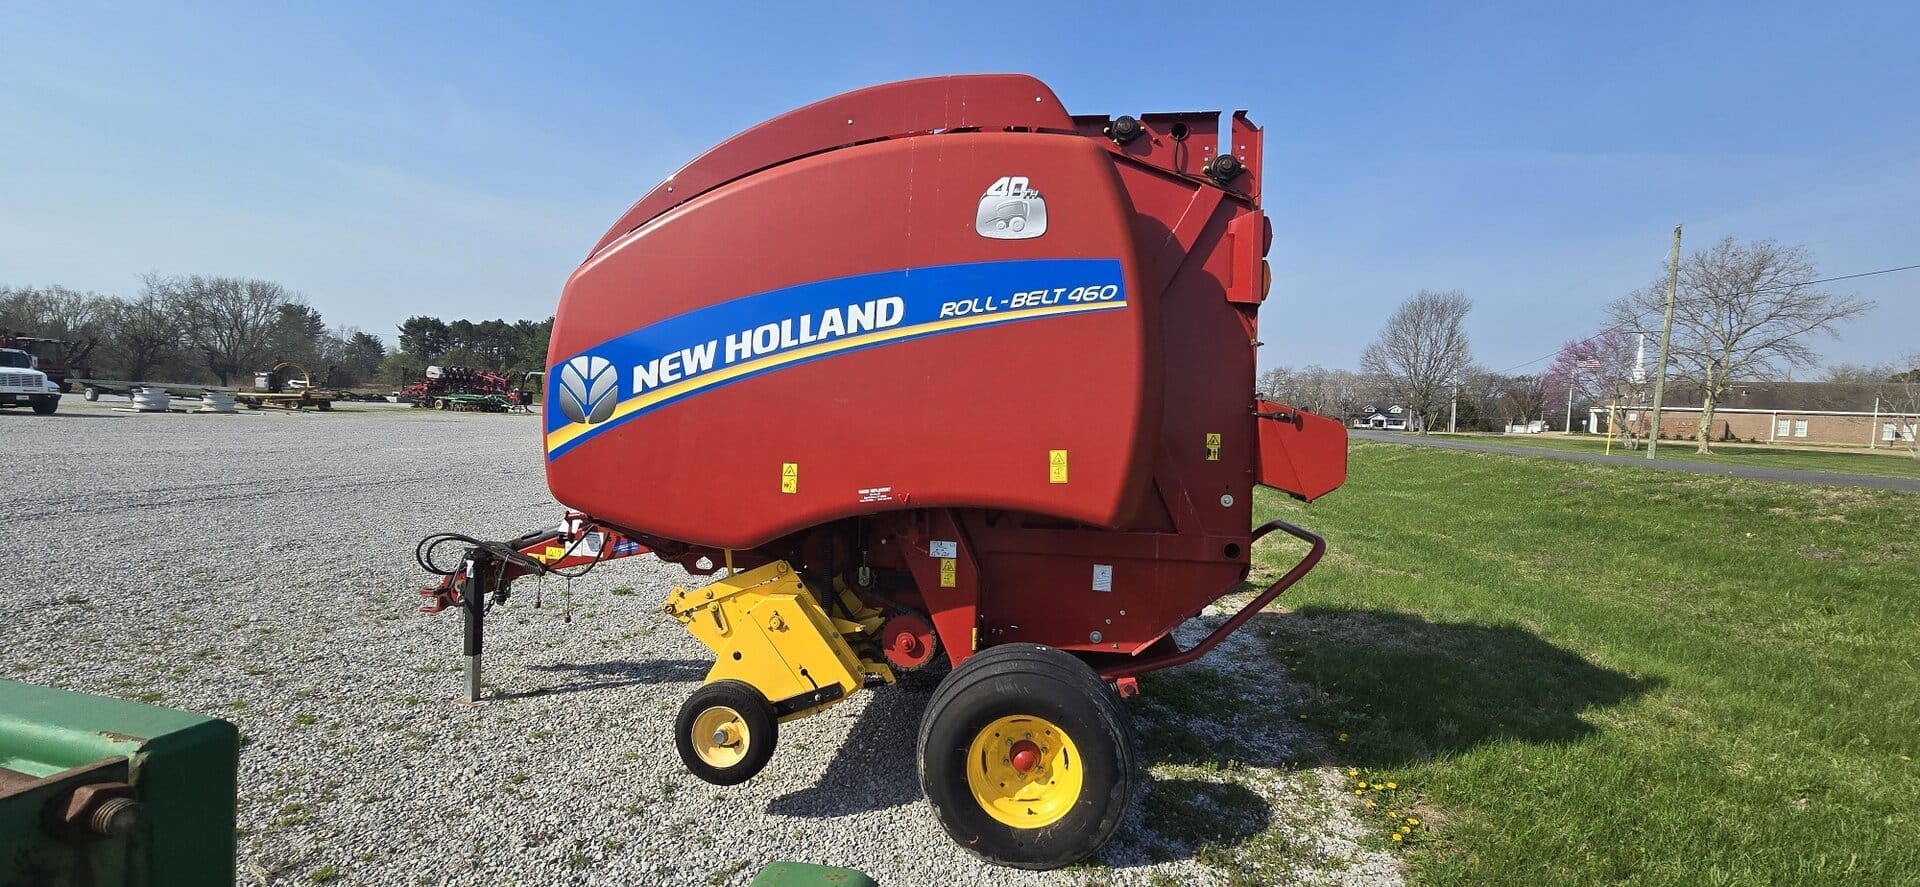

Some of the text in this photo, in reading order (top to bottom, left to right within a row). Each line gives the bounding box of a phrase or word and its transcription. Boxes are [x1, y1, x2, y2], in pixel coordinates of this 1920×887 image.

[940, 285, 1118, 318] ROLL-BELT 460
[632, 296, 904, 394] NEW HOLLAND
